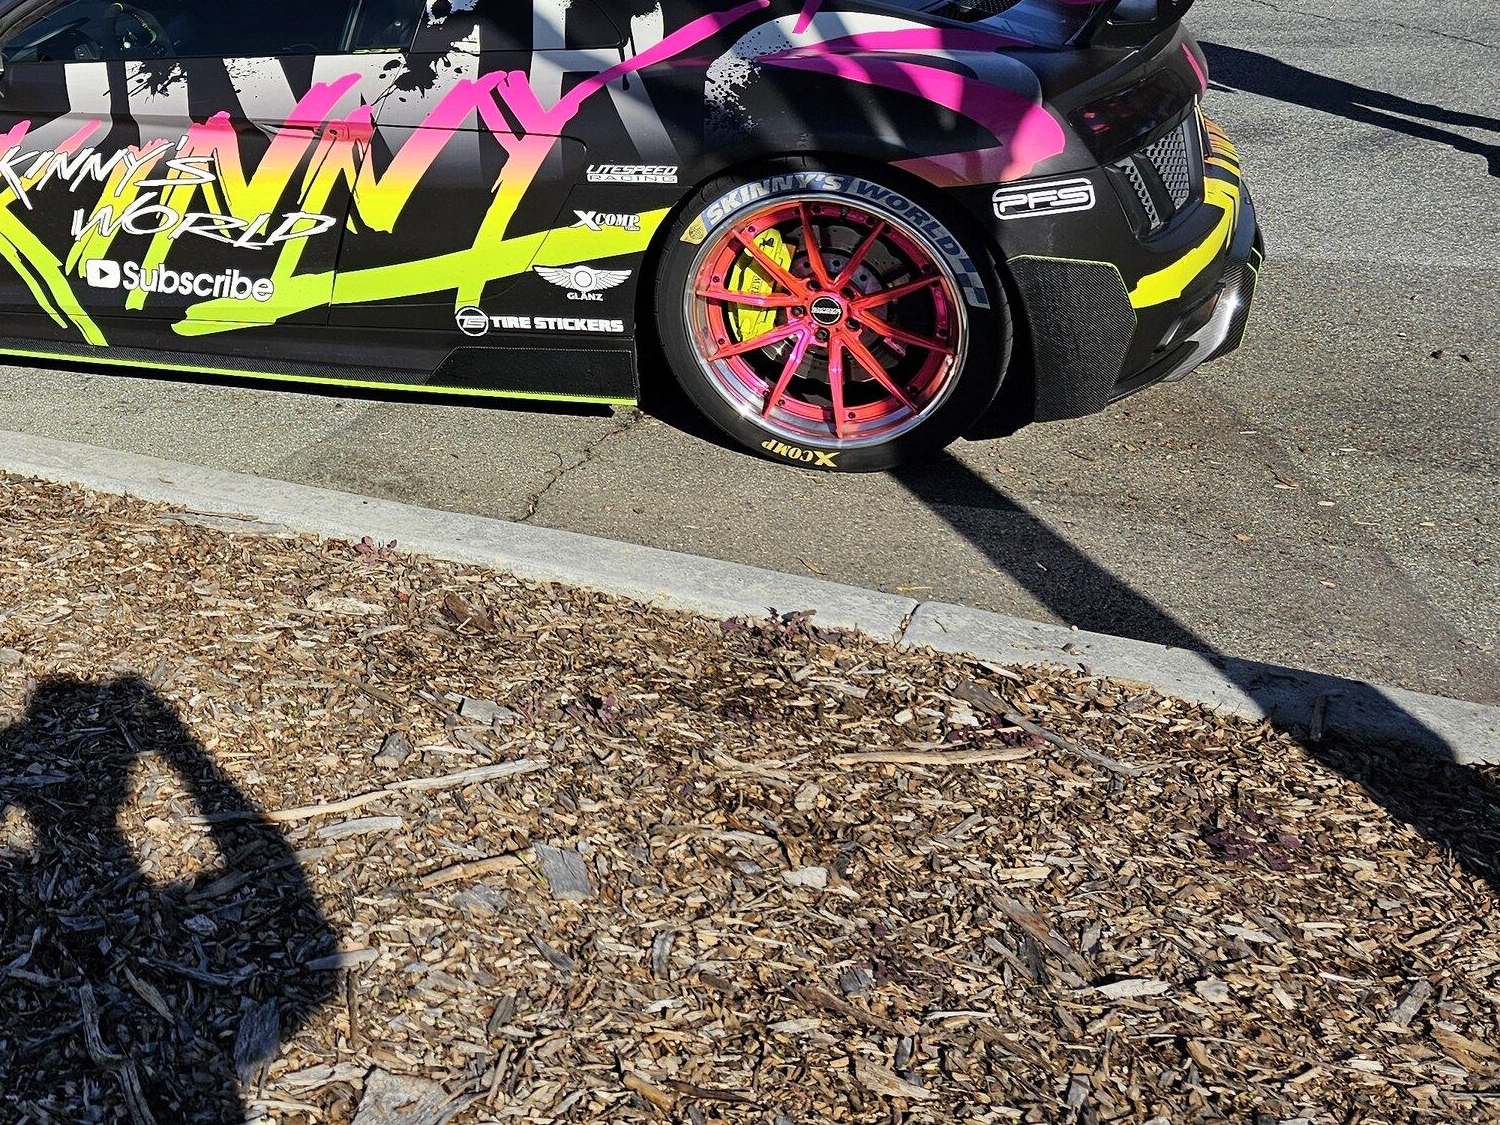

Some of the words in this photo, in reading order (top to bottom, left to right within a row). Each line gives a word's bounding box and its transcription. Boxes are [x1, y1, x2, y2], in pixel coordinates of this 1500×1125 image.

[586, 164, 678, 176] LITESPEED
[589, 175, 676, 183] RACING
[995, 183, 1093, 214] PFS
[71, 192, 337, 251] WORLD
[706, 173, 846, 225] SKINNY'S
[856, 179, 962, 258] WORLD
[123, 261, 275, 302] Subscribe
[489, 315, 531, 329] TIRE
[533, 317, 624, 332] STICKERS
[761, 439, 841, 468] XCOMP
